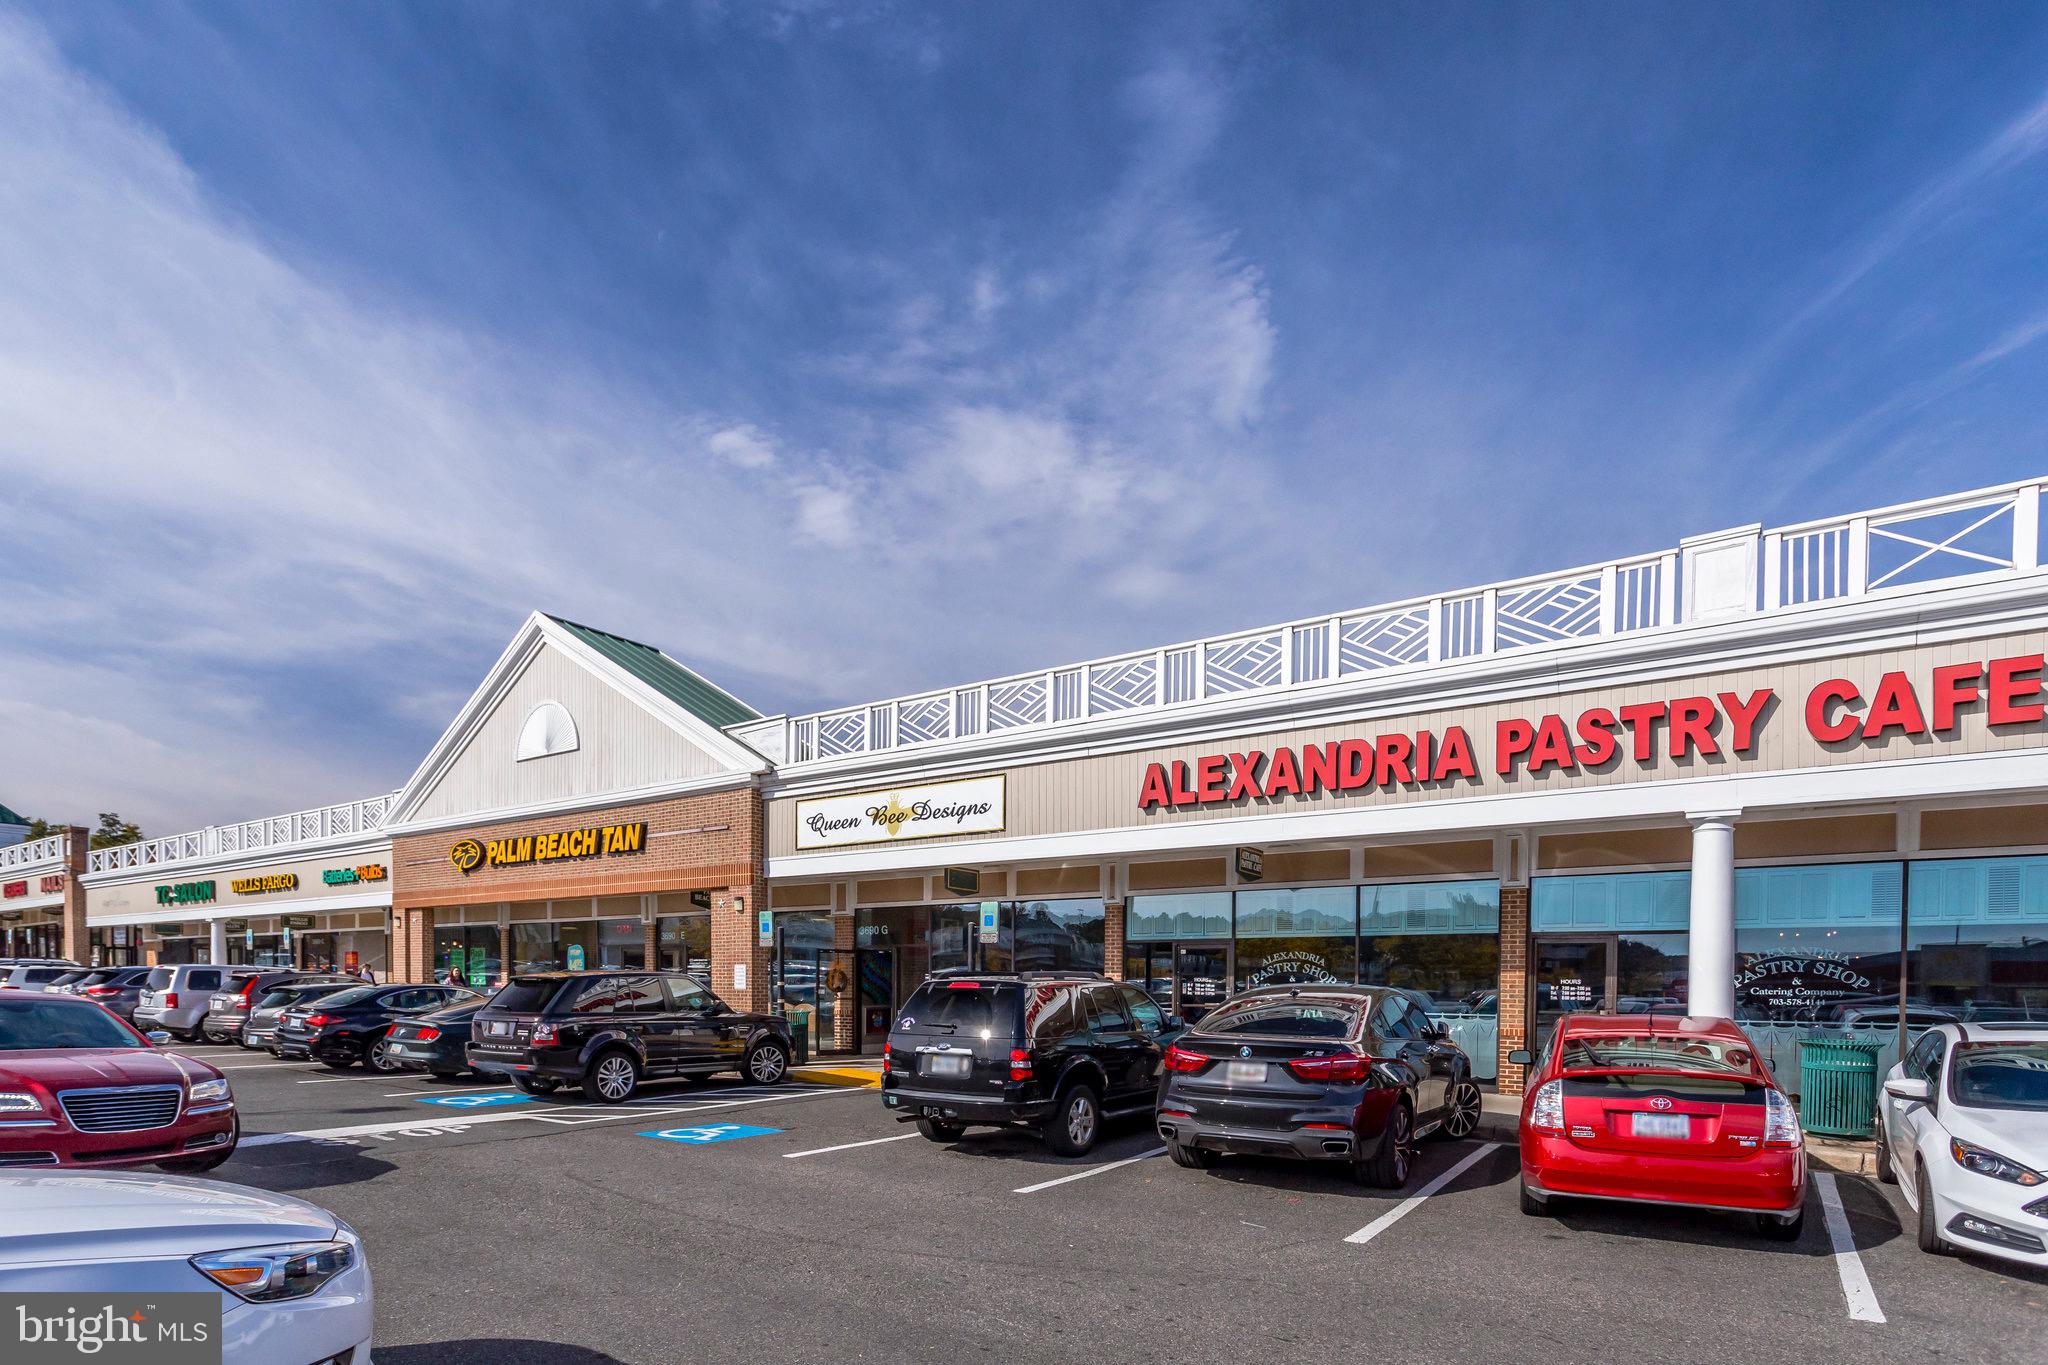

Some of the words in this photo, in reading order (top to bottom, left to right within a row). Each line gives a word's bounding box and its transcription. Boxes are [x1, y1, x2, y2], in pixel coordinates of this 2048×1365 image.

[1138, 725, 1475, 808] ALEXANDRIA
[1496, 688, 1774, 775] PASTRY
[1805, 654, 2044, 742] CAFE
[806, 812, 862, 838] Queen
[865, 805, 908, 826] Bee
[911, 799, 992, 826] Designs
[486, 836, 533, 865] PALM
[535, 828, 598, 861] BEACH
[602, 823, 641, 854] TAN
[173, 880, 213, 902] SALON
[231, 877, 260, 893] WELLS
[262, 874, 295, 890] FARGO
[661, 931, 676, 940] 3690
[681, 931, 685, 940] E
[860, 925, 879, 935] 3690
[881, 925, 888, 935] G
[1261, 951, 1326, 966] ALEXANDRIA
[1746, 946, 1850, 966] ALEXANDRIA
[1251, 962, 1301, 984] PASTRY
[1302, 963, 1338, 984] SHOP
[1289, 975, 1296, 983] &
[1733, 960, 1811, 989] PASTRY
[1813, 961, 1871, 990] SHOP
[1791, 977, 1802, 986] &
[1750, 987, 1794, 998] Catering
[1795, 987, 1845, 998] Company
[1768, 998, 1826, 1006] 703-578-4144
[311, 1123, 471, 1146] STOP
